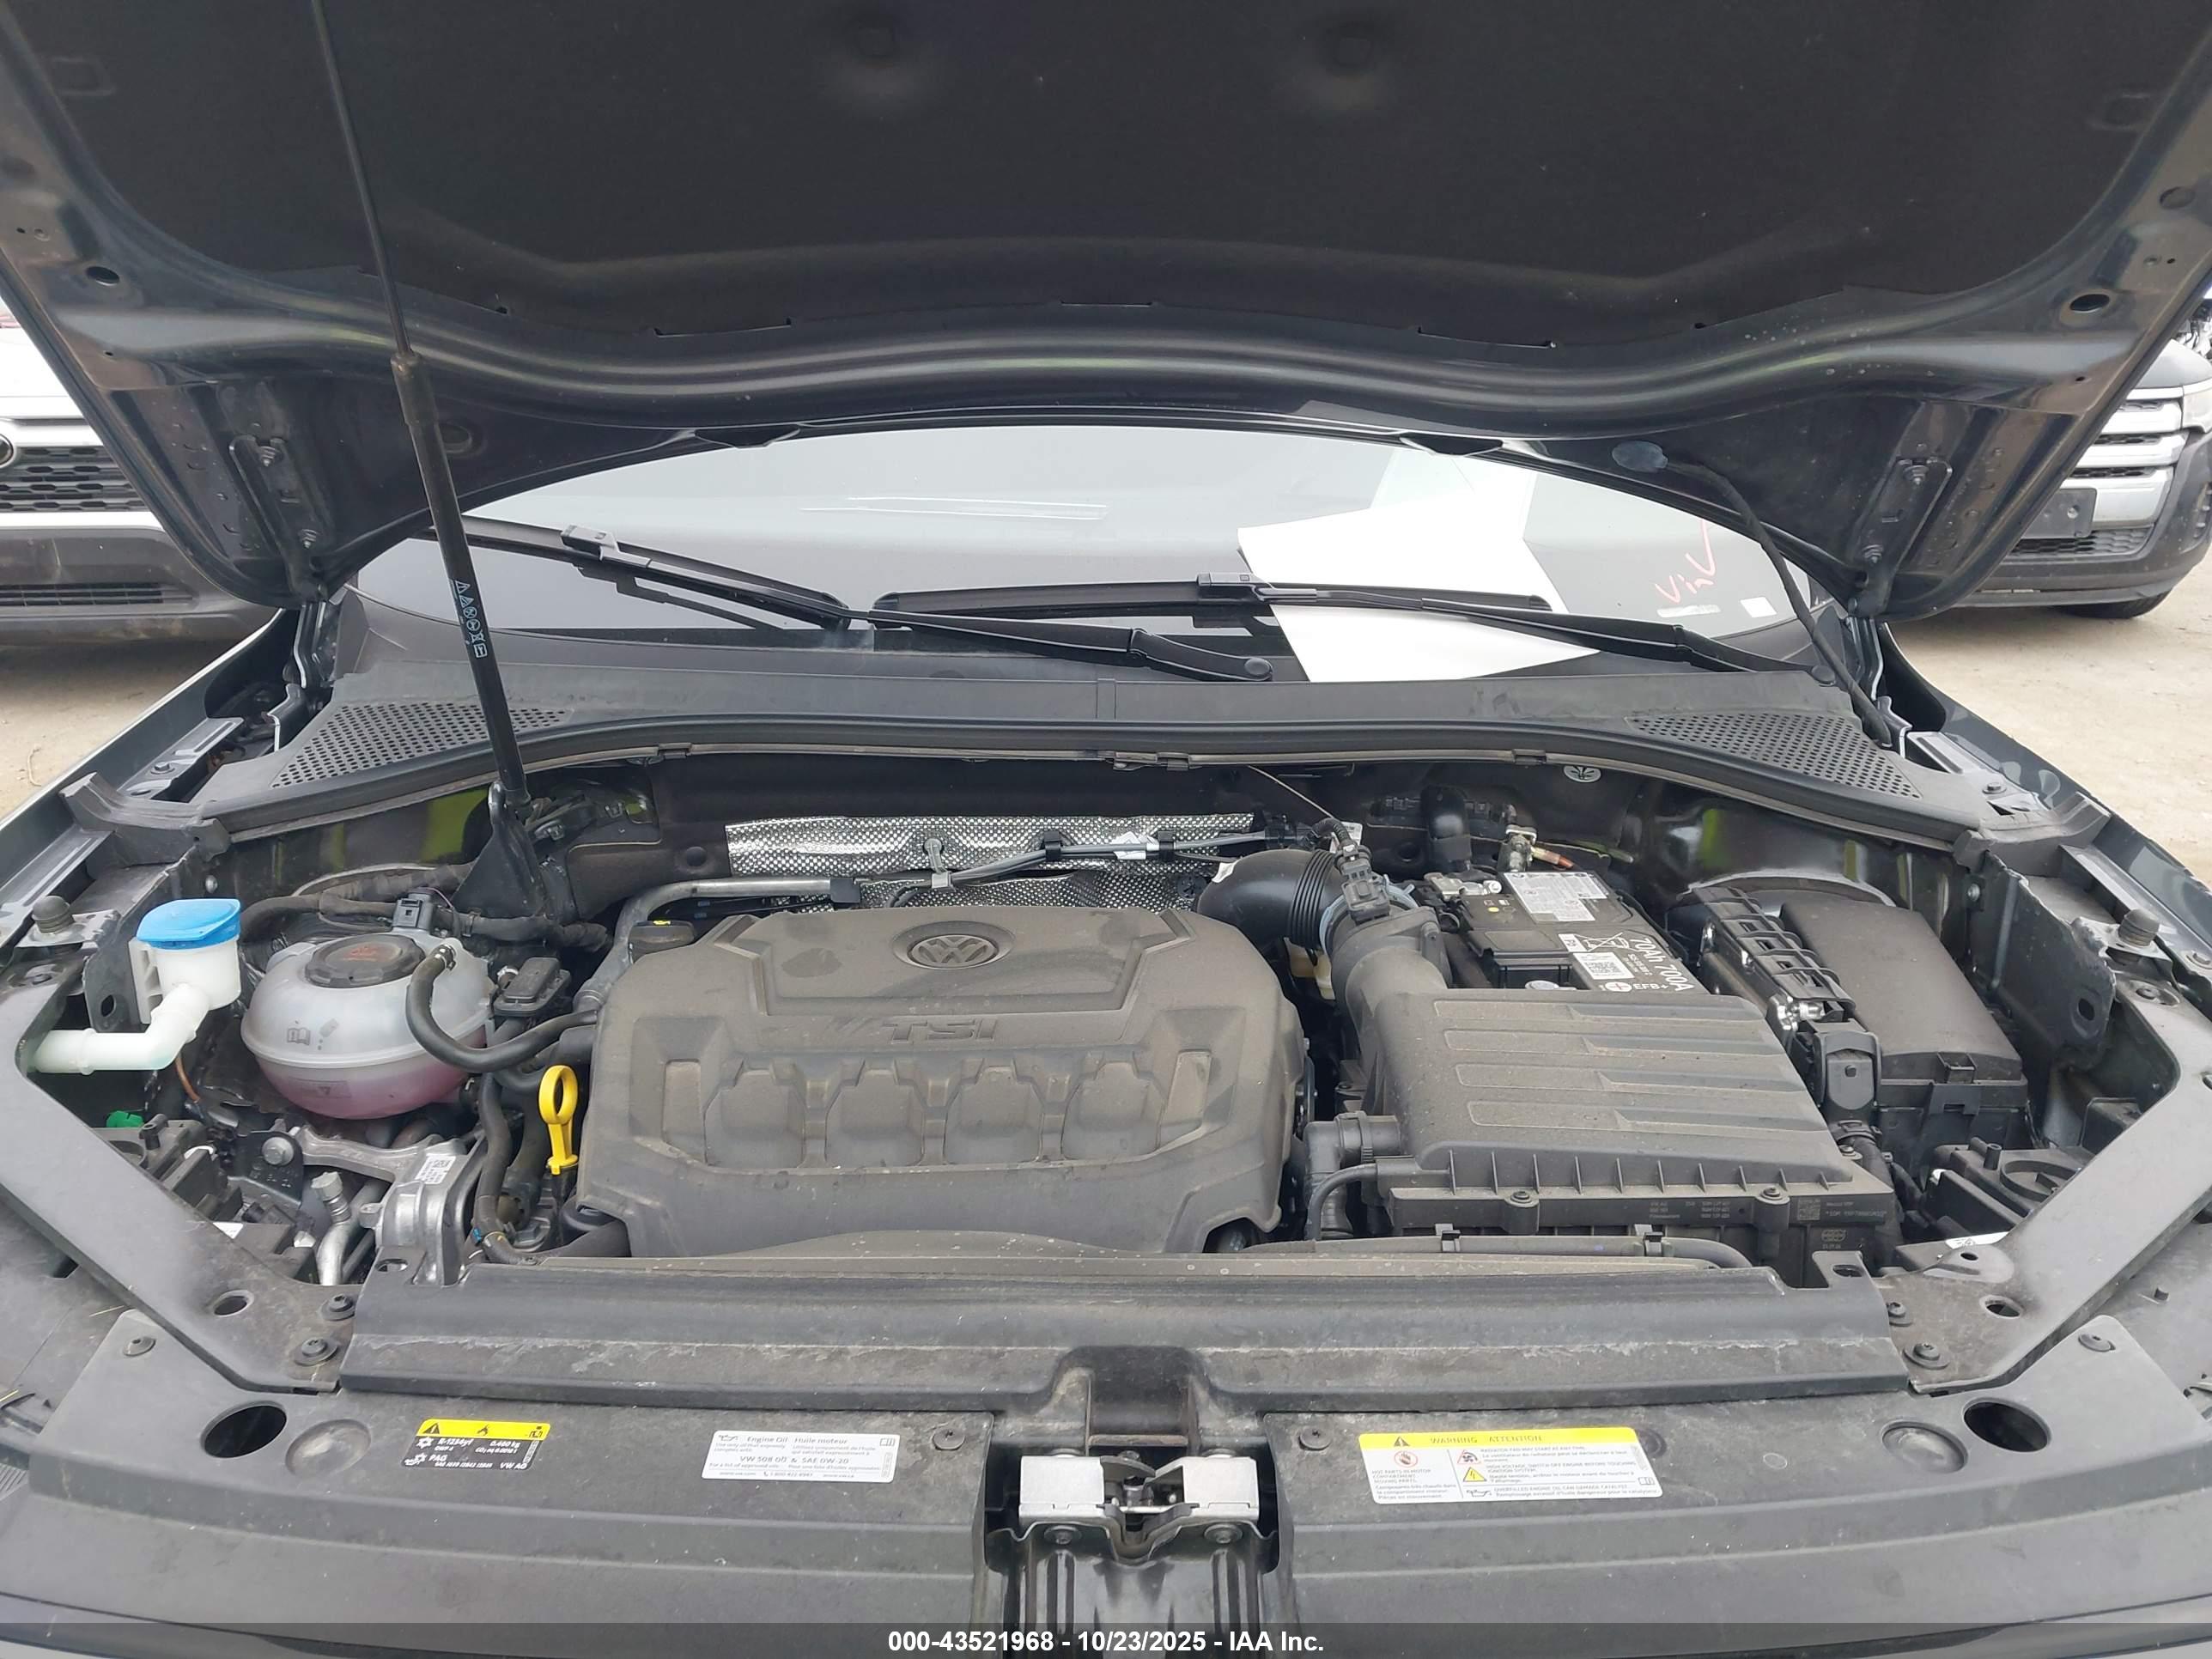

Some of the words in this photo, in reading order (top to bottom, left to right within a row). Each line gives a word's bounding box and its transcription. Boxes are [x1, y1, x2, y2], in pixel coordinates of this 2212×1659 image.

[1629, 938, 1667, 963] 70Ah
[1654, 963, 1695, 991] 700A
[882, 1019, 998, 1045] TSI
[1489, 1435, 1542, 1443] ATTENTION
